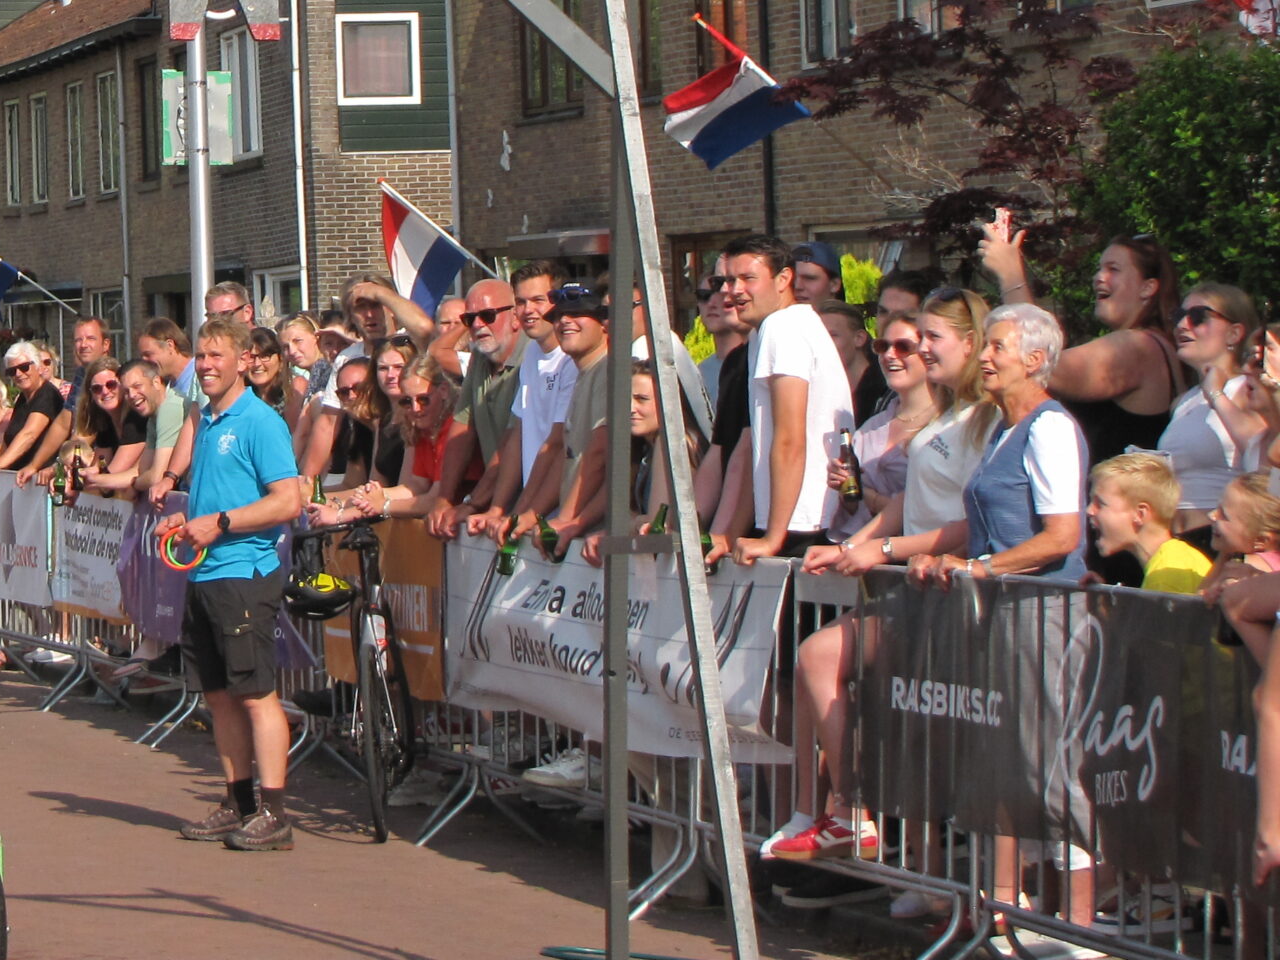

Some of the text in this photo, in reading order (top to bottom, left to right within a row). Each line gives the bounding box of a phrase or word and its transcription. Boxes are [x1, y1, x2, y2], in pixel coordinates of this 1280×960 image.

[93, 506, 123, 534] complete
[507, 625, 550, 668] lekker
[549, 633, 603, 677] koud
[1095, 770, 1128, 807] BIKES
